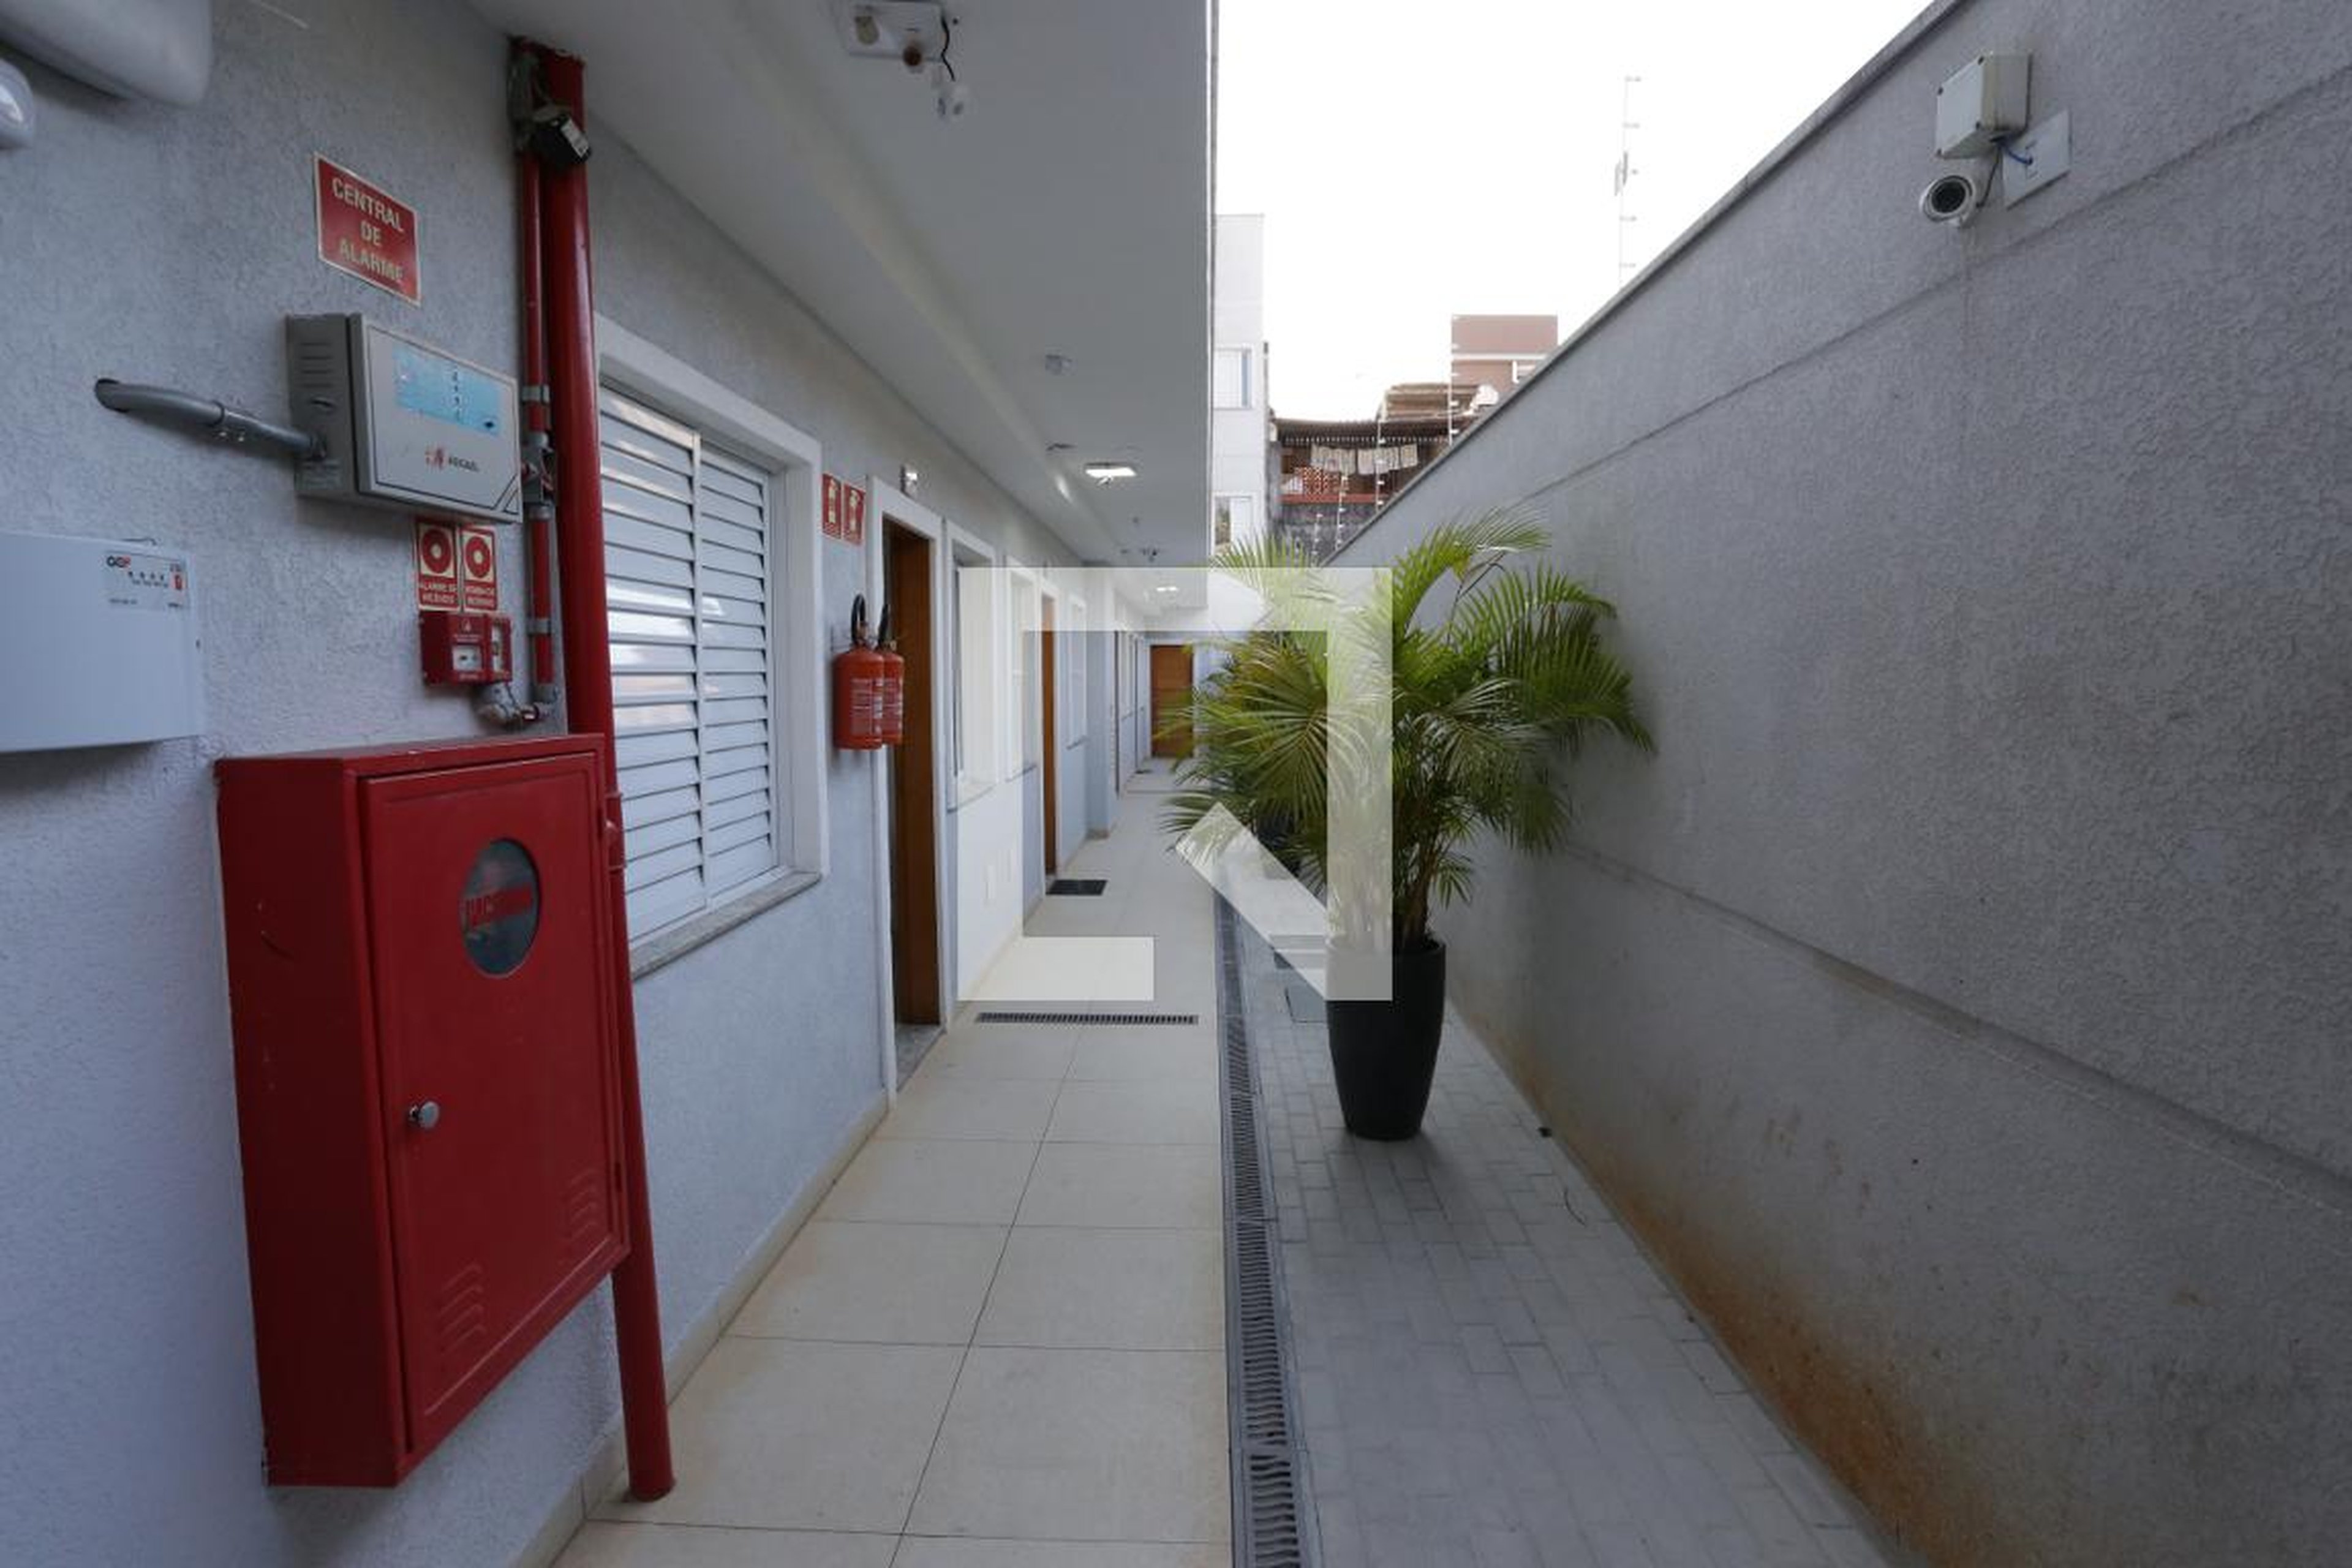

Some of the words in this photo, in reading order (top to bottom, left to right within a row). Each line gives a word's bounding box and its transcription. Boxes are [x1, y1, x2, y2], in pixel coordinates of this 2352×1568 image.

[332, 178, 404, 233] CENTRAL
[361, 220, 382, 246] DE
[339, 237, 404, 280] ALARME
